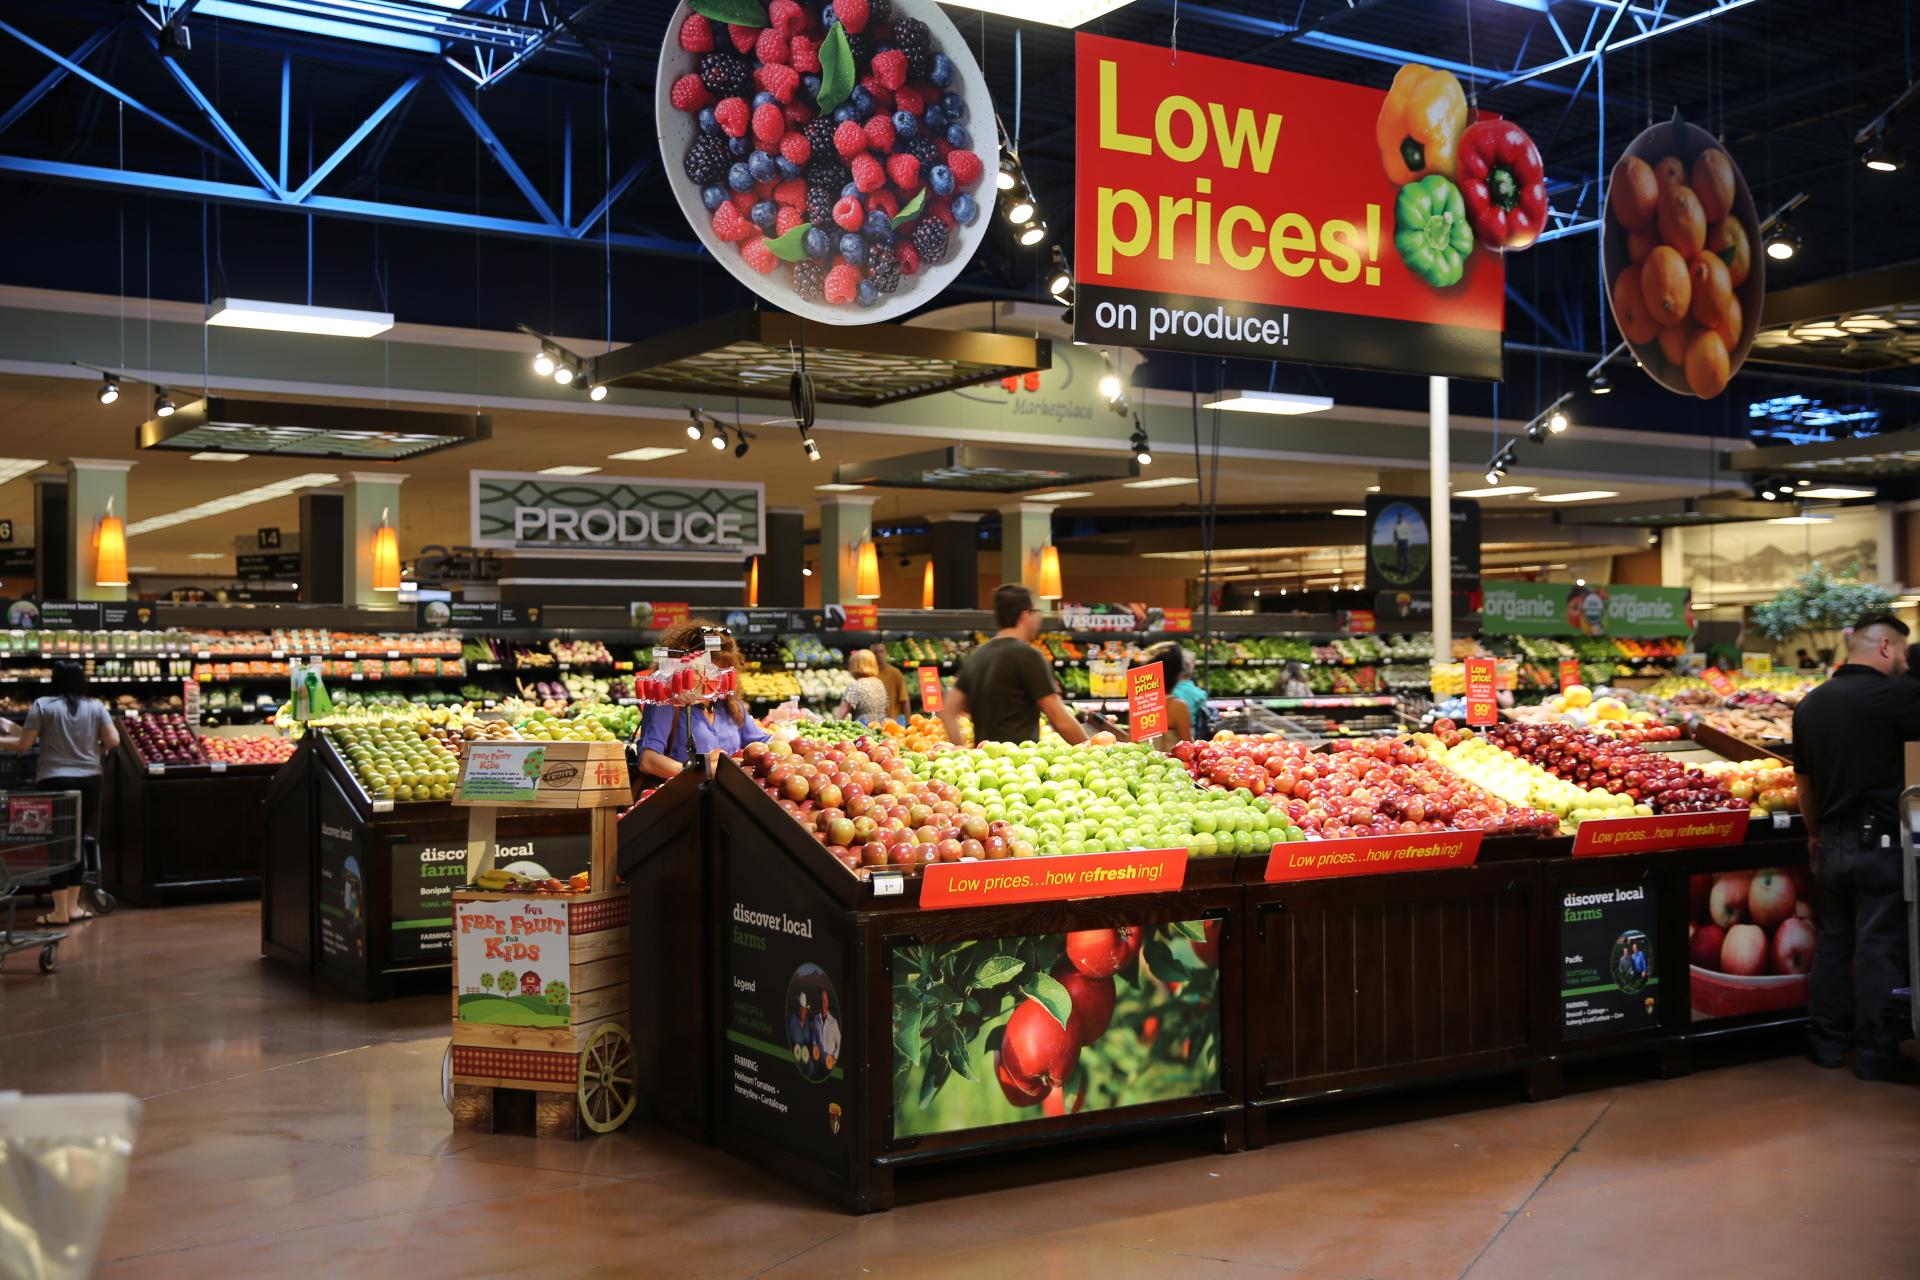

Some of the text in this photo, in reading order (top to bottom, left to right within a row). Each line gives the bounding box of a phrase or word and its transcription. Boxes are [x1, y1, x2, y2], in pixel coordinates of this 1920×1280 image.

[1099, 58, 1283, 174] Low
[1096, 177, 1382, 287] prices!
[1095, 301, 1290, 346] on produce!
[514, 505, 744, 545] PRODUCE
[1484, 594, 1555, 621] organic
[1608, 597, 1673, 624] organic
[1062, 614, 1136, 628] VARIETIES
[1470, 664, 1488, 674] Low
[1134, 673, 1153, 685] Low
[1135, 678, 1160, 696] price!
[1592, 832, 1613, 844] Low
[421, 842, 535, 862] disco local
[1289, 854, 1315, 868] Low
[421, 863, 466, 877] farm
[420, 886, 452, 896] Bonipak
[948, 877, 981, 892] Low
[1563, 886, 1644, 907] discover local
[733, 902, 813, 938] discover local
[1564, 908, 1603, 922] farms
[461, 914, 566, 936] FREE FRUIT
[734, 926, 767, 951] farms
[734, 975, 756, 992] Legend
